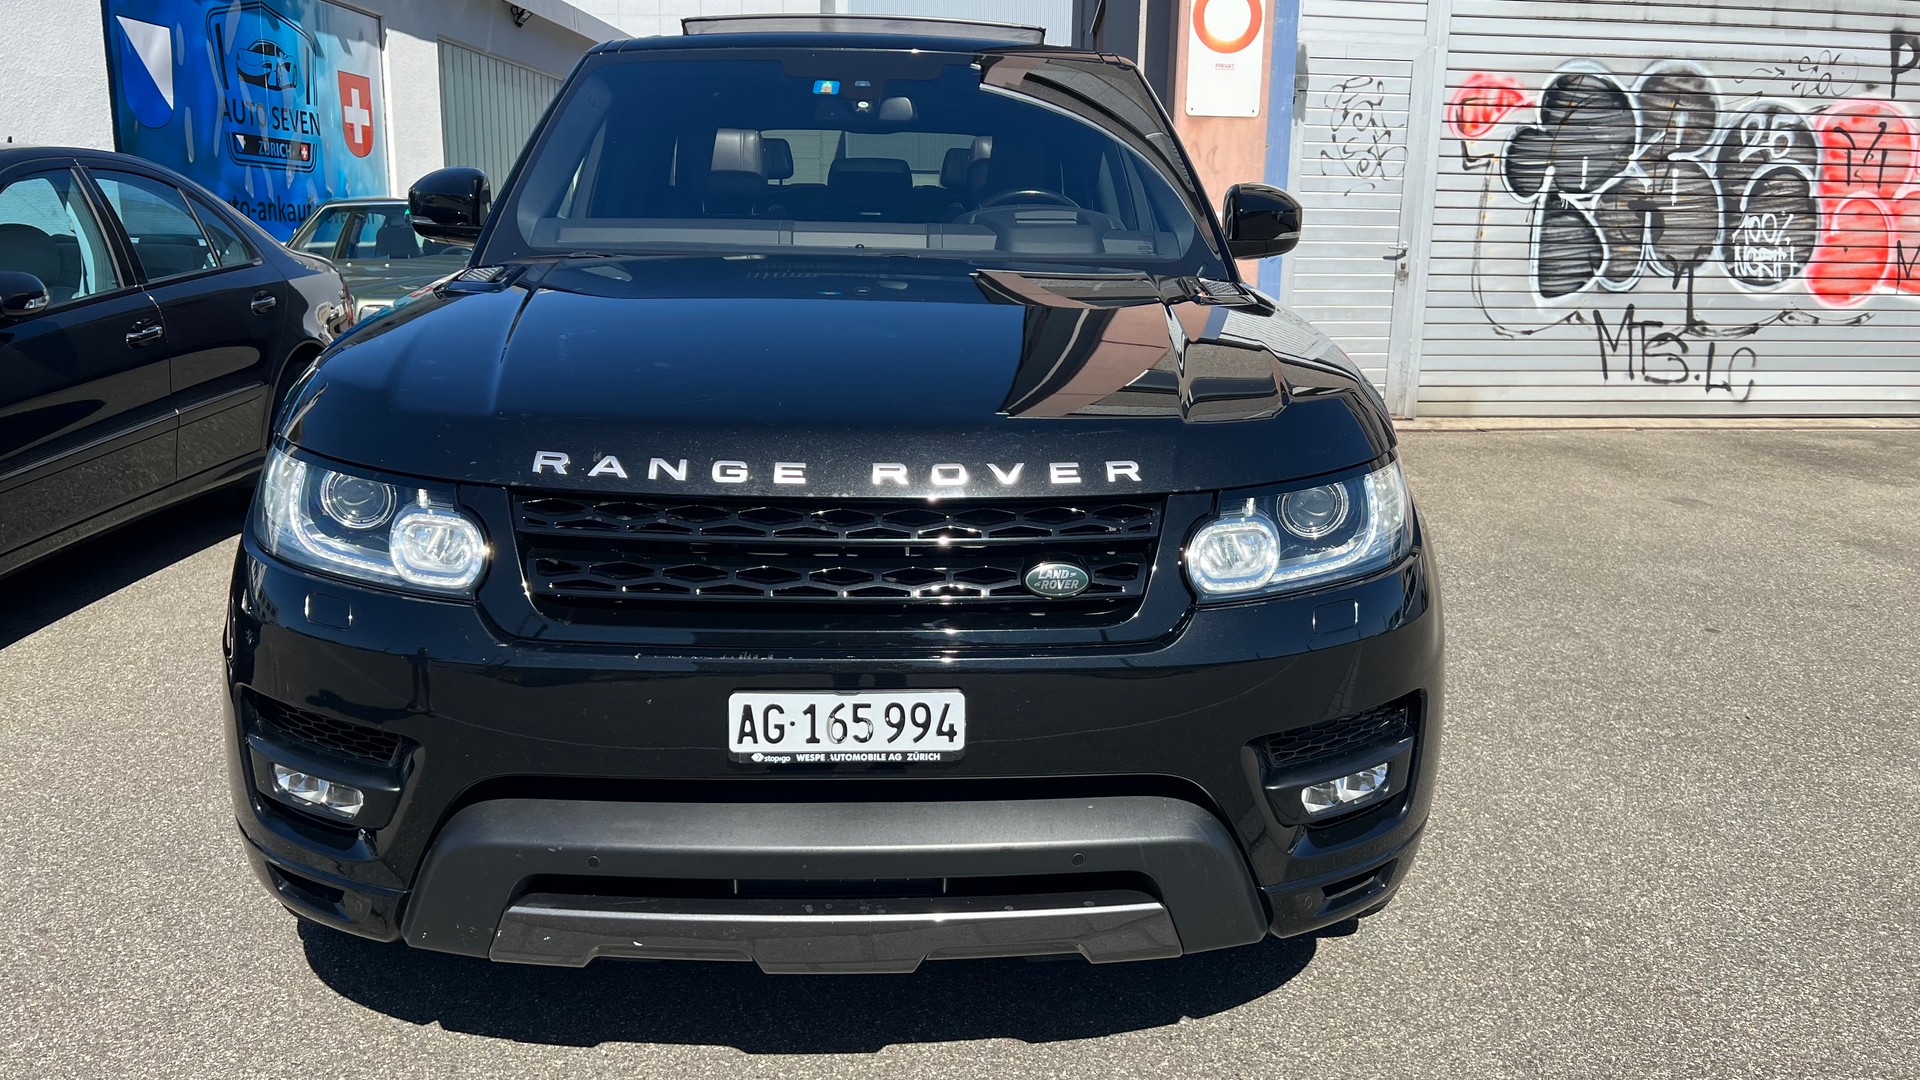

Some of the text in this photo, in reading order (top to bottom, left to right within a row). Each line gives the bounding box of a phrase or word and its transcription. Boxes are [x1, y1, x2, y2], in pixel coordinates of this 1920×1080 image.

[223, 98, 321, 136] AUTO SEVEN
[532, 450, 1143, 486] RANGE ROVER
[1037, 569, 1069, 580] LAND
[1040, 580, 1079, 590] ROVER
[796, 753, 826, 762] WESPE
[888, 753, 902, 762] AG
[906, 751, 941, 761] ZÜRICH
